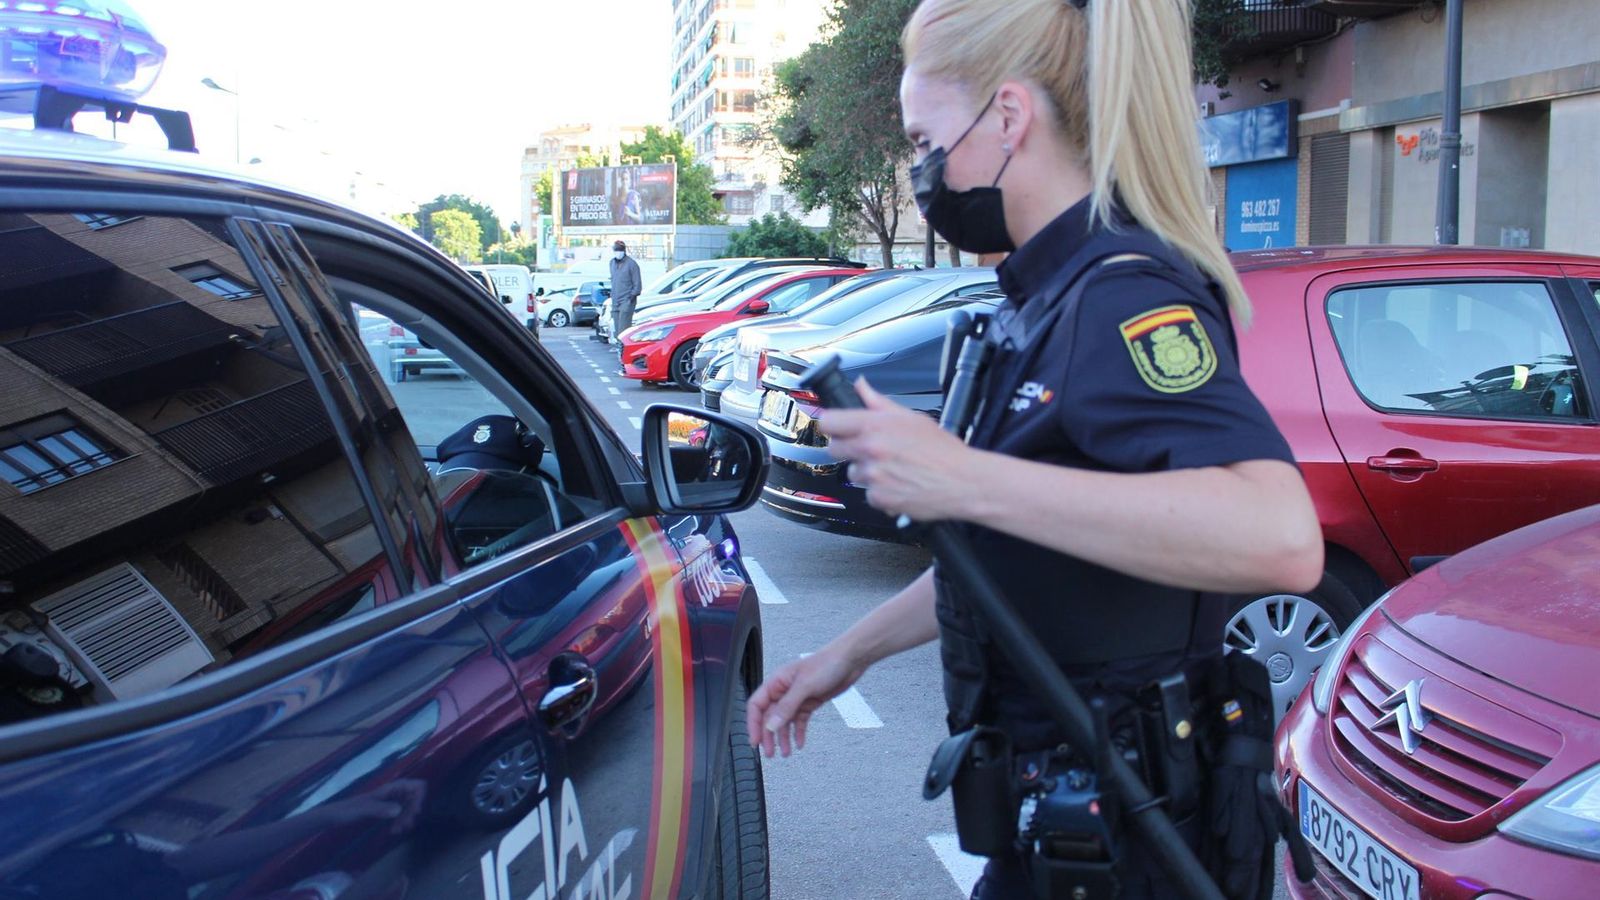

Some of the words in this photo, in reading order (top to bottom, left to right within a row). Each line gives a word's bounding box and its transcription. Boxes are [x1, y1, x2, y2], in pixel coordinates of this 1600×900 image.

[1241, 201, 1253, 218] 963
[1254, 200, 1267, 216] 482
[1268, 199, 1280, 216] 267
[1311, 799, 1360, 879] 8792
[1366, 846, 1411, 900] CRY
